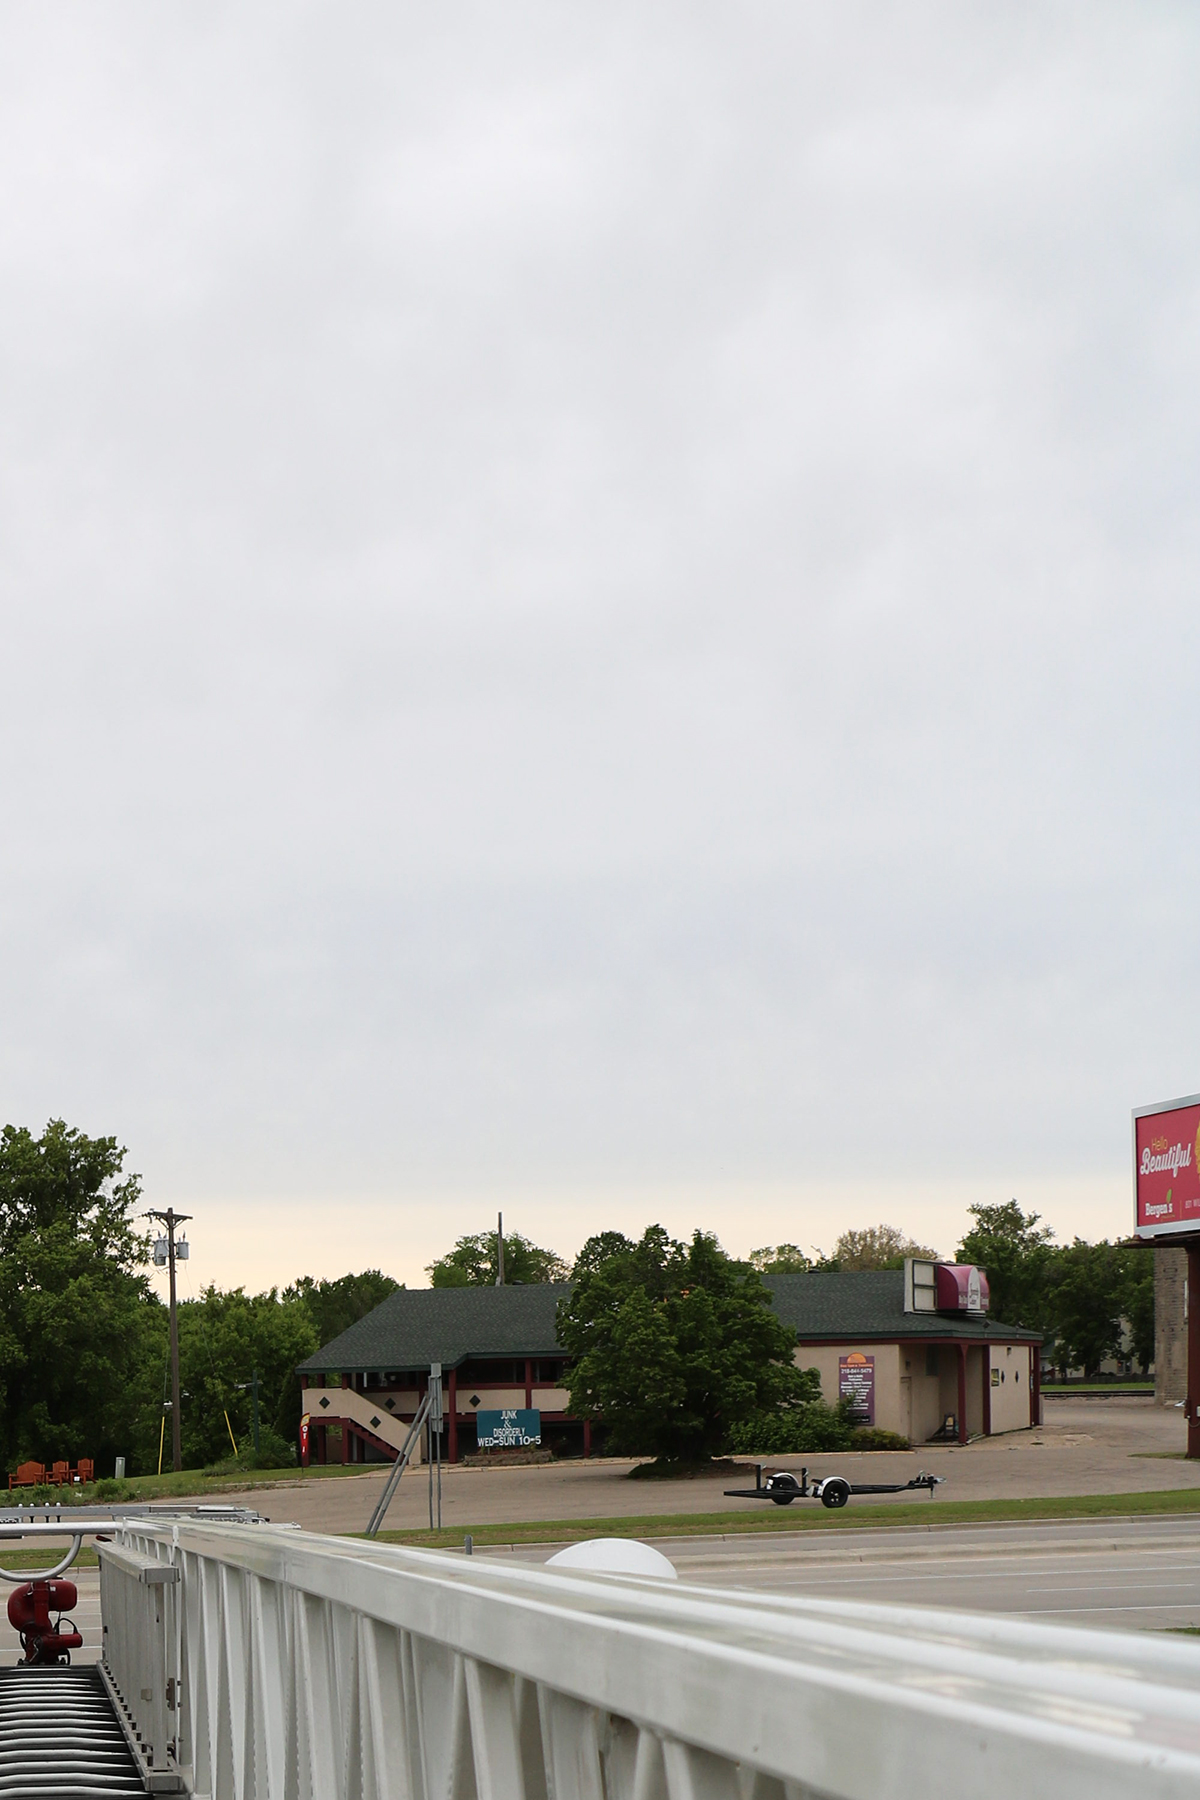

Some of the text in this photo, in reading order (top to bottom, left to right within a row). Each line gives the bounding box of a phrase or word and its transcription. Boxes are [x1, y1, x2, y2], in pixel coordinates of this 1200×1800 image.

[1152, 1137, 1168, 1151] Hello
[1140, 1143, 1192, 1178] Beautiful
[501, 1410, 517, 1419] JUNK
[503, 1420, 511, 1428] &
[493, 1427, 525, 1437] DISORDERLY
[478, 1435, 541, 1447] WED-SUN 10-5
